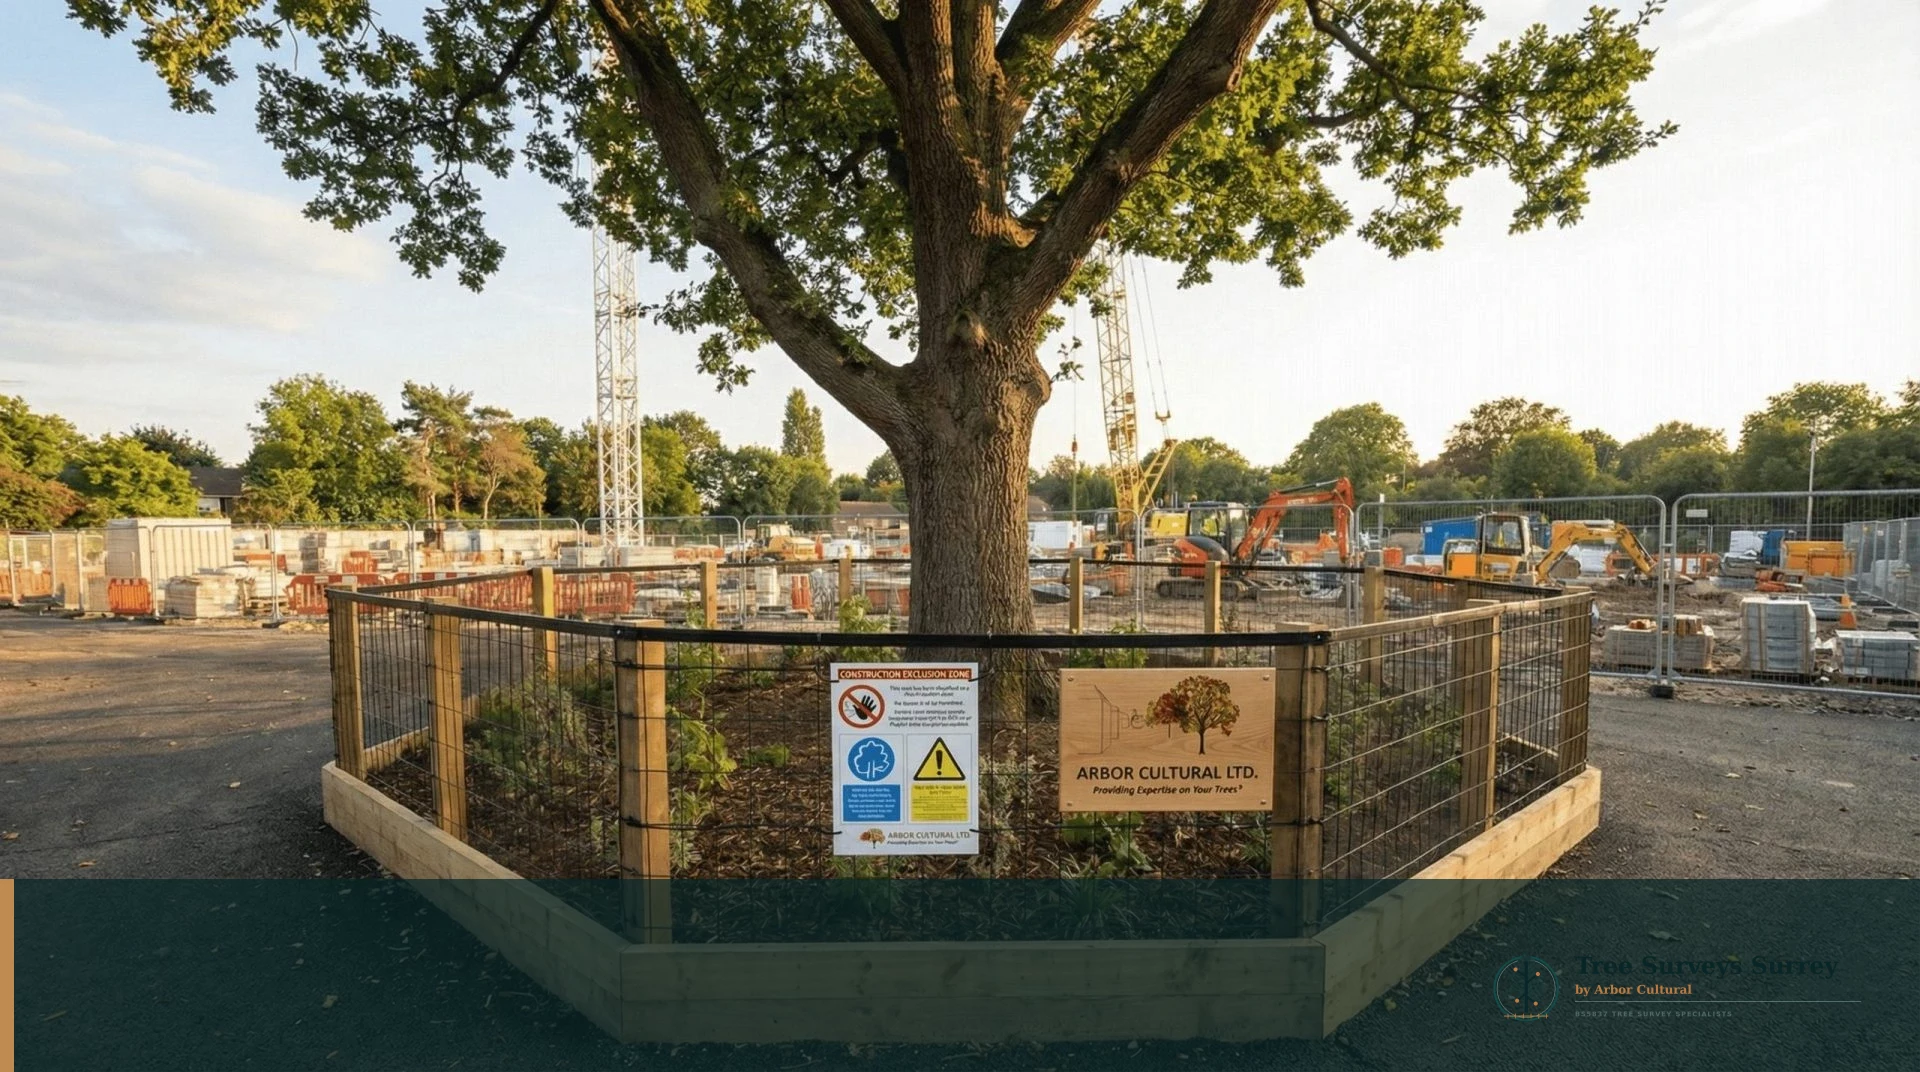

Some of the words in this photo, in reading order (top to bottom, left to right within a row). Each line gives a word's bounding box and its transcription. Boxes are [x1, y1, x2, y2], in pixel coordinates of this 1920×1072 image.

[840, 670, 900, 678] CONSTRUCTION
[903, 670, 946, 678] EXCLUSION
[949, 670, 970, 678] ZONE
[1077, 767, 1134, 780] ARBOR
[1139, 767, 1222, 780] CULTURAL
[1227, 766, 1259, 779] LTD.
[1093, 786, 1135, 796] Providing
[1137, 786, 1177, 795] Expertise
[1193, 786, 1213, 794] Your
